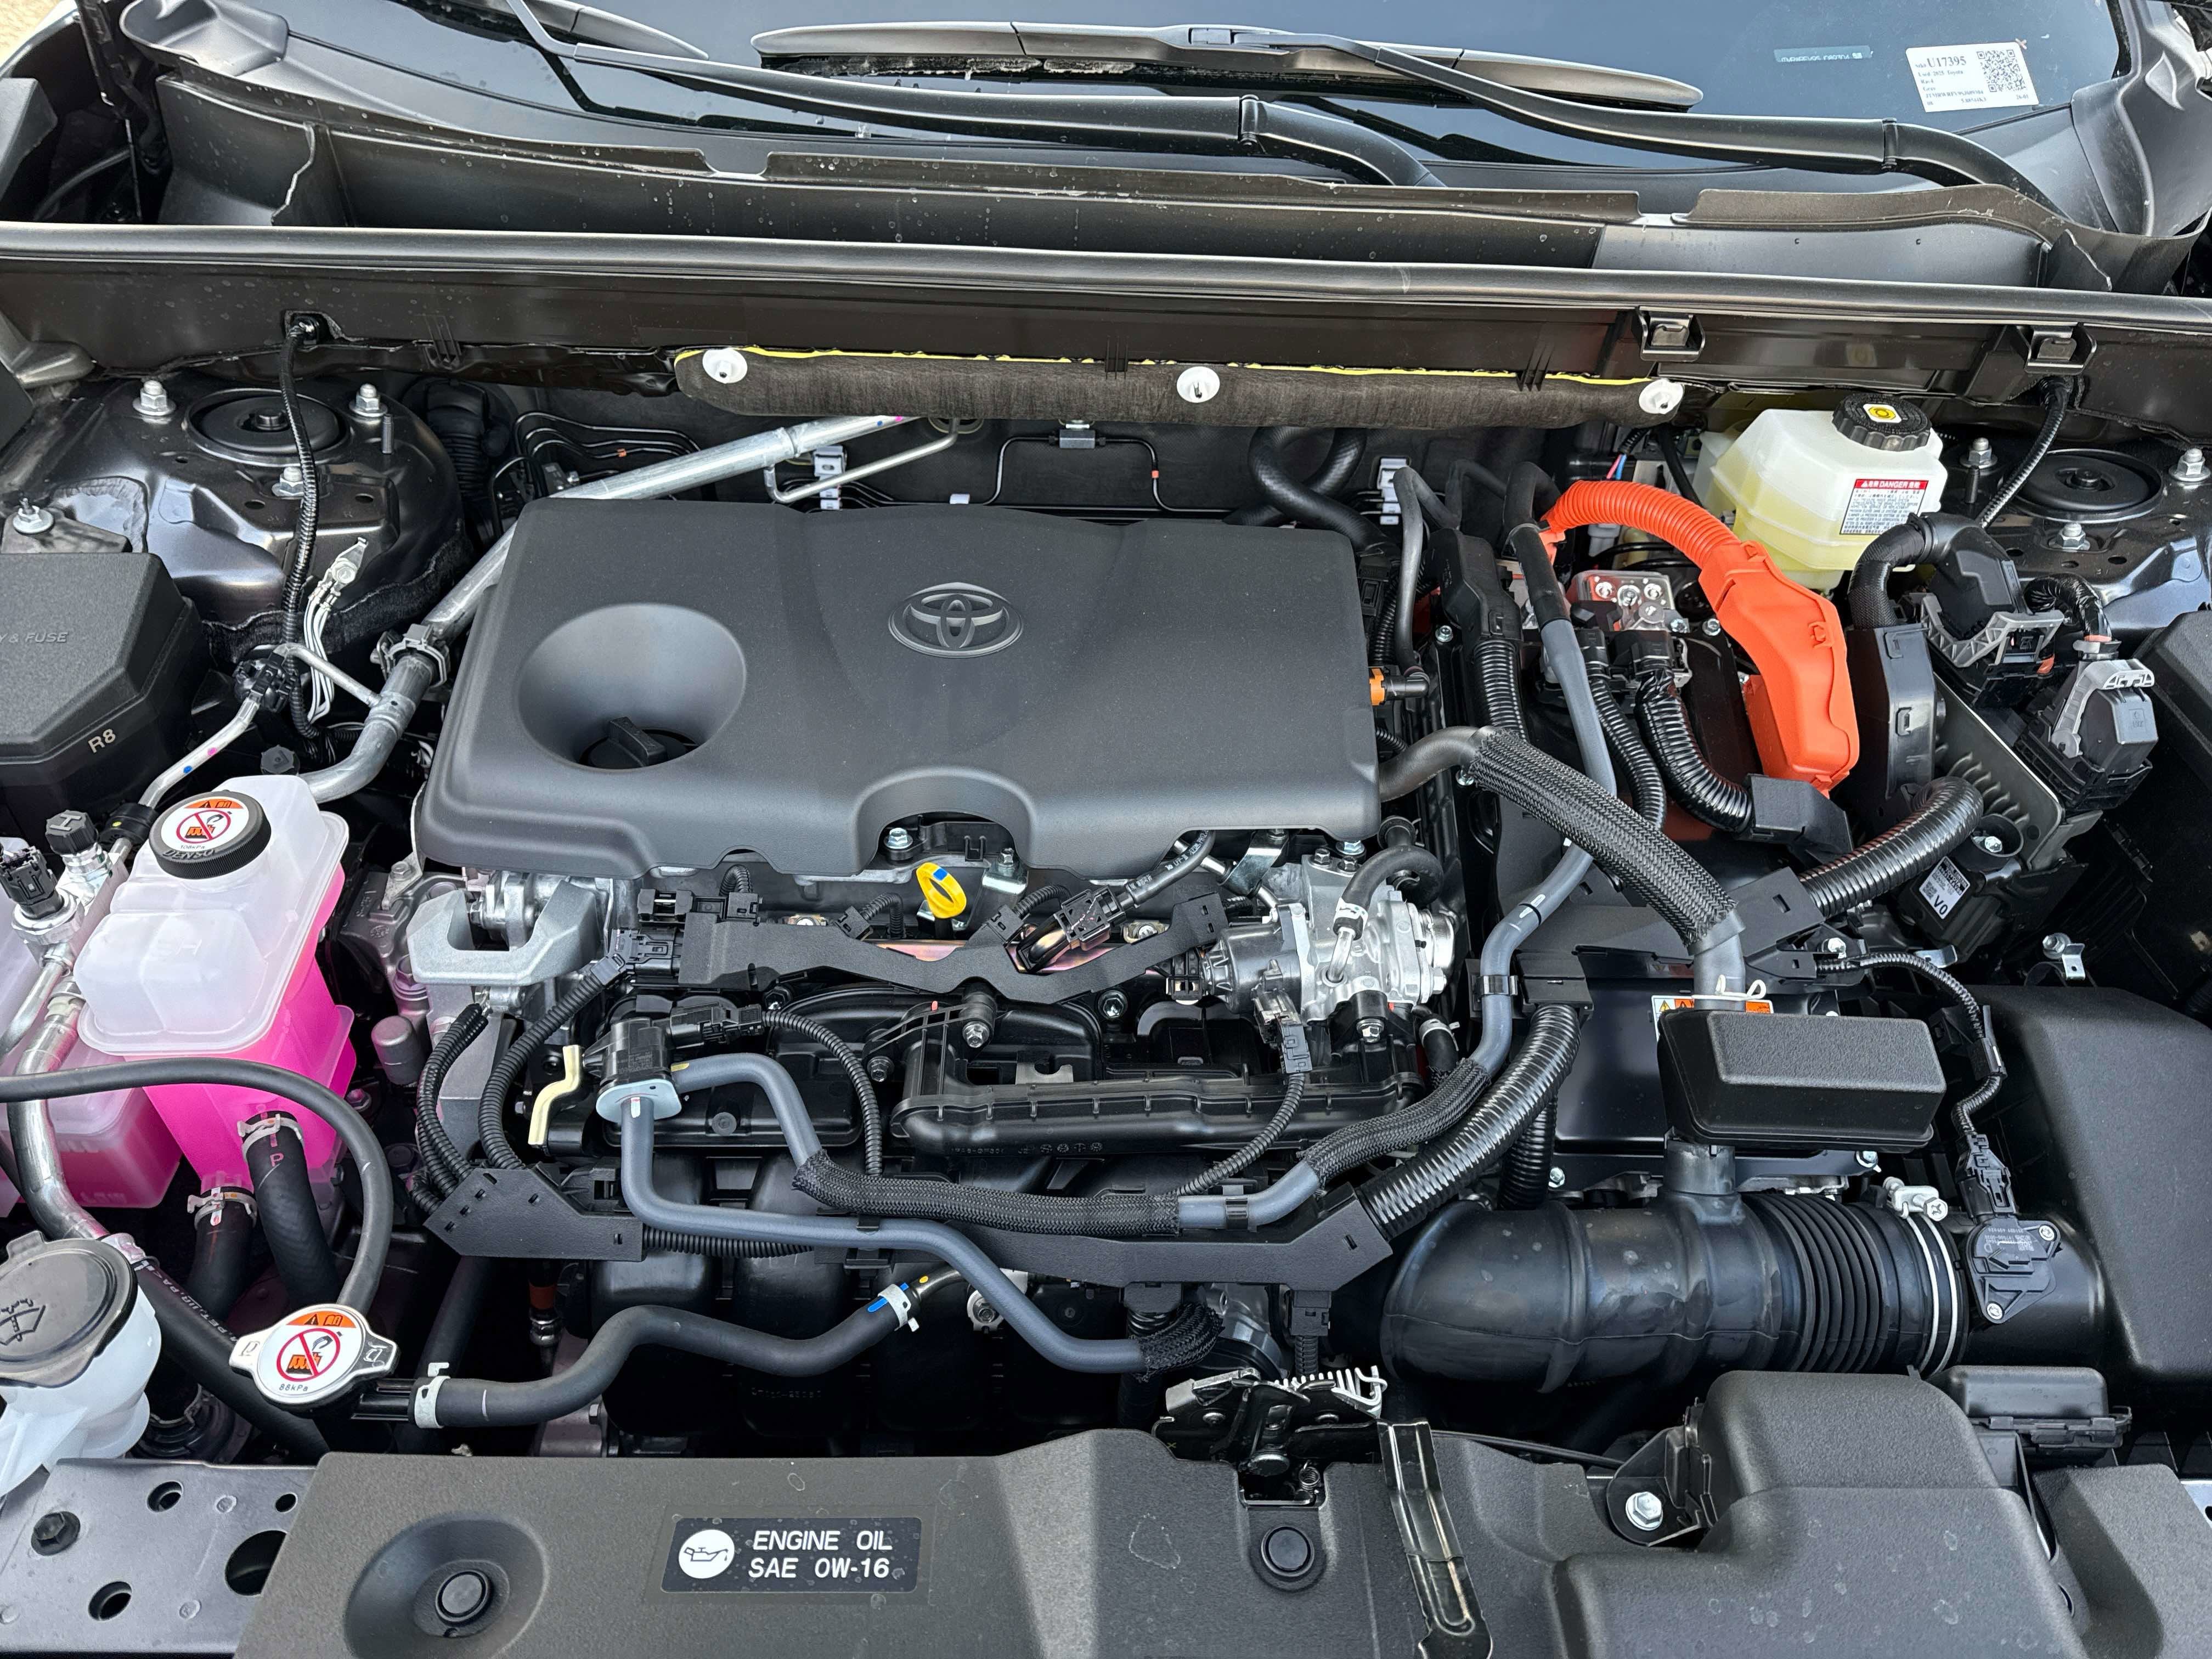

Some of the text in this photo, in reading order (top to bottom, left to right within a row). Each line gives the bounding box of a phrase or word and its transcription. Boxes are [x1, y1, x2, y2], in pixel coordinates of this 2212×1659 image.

[1927, 56, 1966, 67] U17395
[25, 631, 69, 643] FUSE
[88, 729, 115, 753] R8
[162, 849, 216, 860] DENSO
[270, 1152, 284, 1167] P
[279, 1383, 308, 1392] 88kPa
[752, 1530, 893, 1551] ENGINE OIL
[748, 1558, 890, 1578] SAE 0W-16
